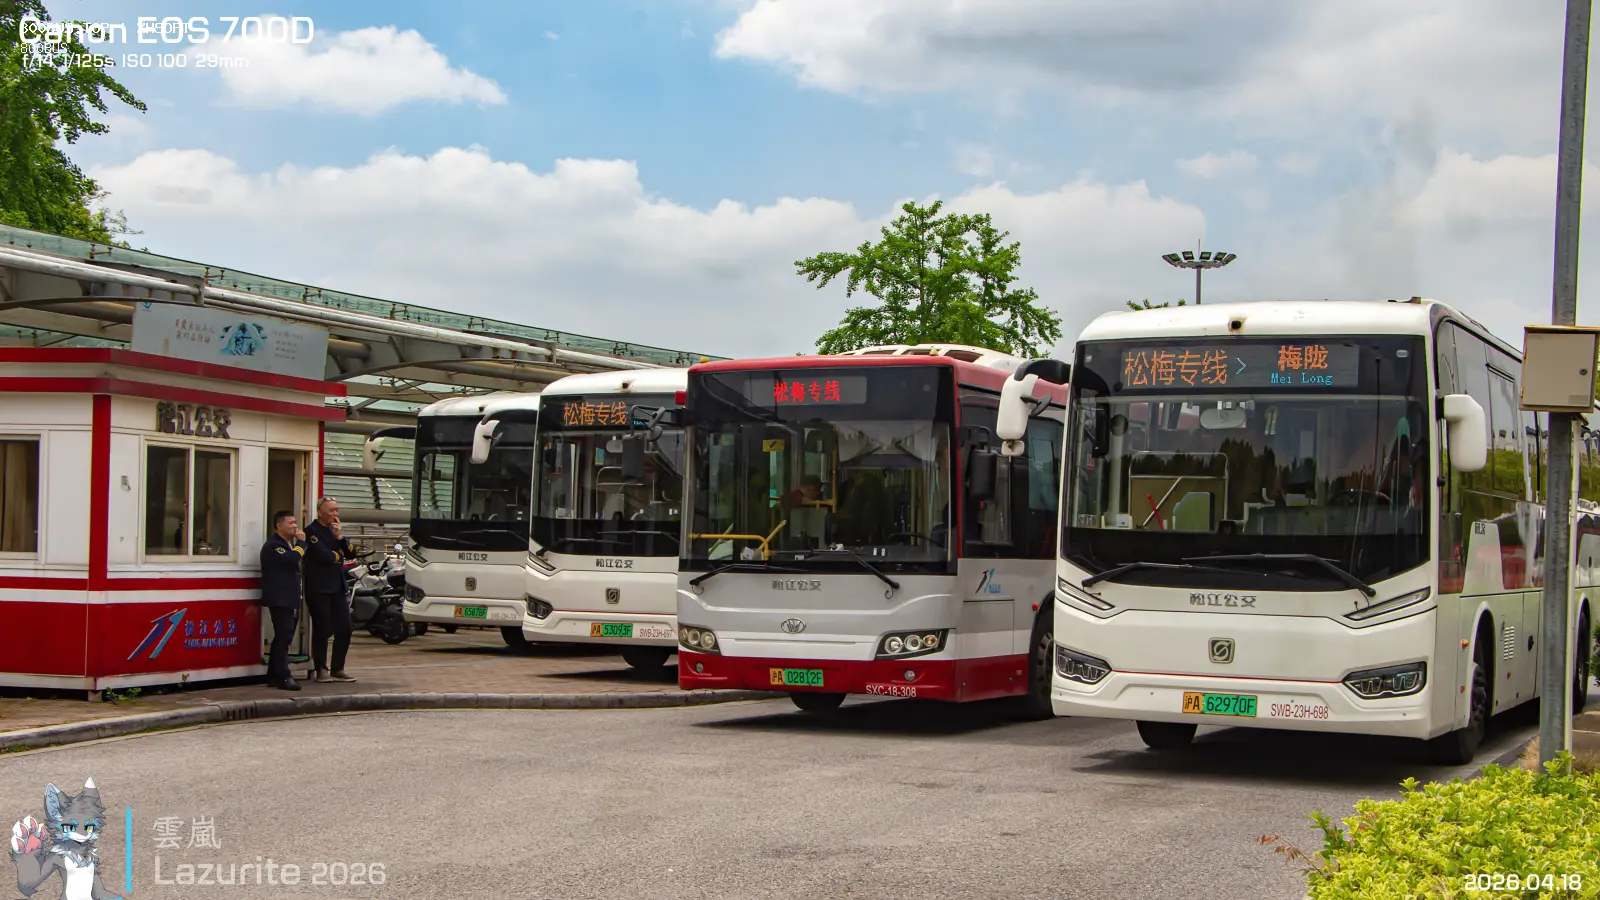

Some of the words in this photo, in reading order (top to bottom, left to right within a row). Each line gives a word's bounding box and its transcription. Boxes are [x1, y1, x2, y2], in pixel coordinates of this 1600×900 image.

[1124, 349, 1228, 386] 松梅专线
[1277, 344, 1329, 372] 梅陇
[1271, 373, 1292, 384] Mei
[1301, 373, 1333, 386] Long
[773, 380, 841, 403] 松梅专线
[563, 401, 627, 425] 松梅专线
[596, 558, 633, 569] 松江公交
[772, 580, 822, 591] 松江公交
[1189, 593, 1256, 608] 松江公交
[184, 619, 237, 637] 松江公交
[866, 685, 916, 698] SXC-18-308
[1206, 696, 1256, 713] 62970F
[1271, 703, 1329, 719] SWB-23H-698
